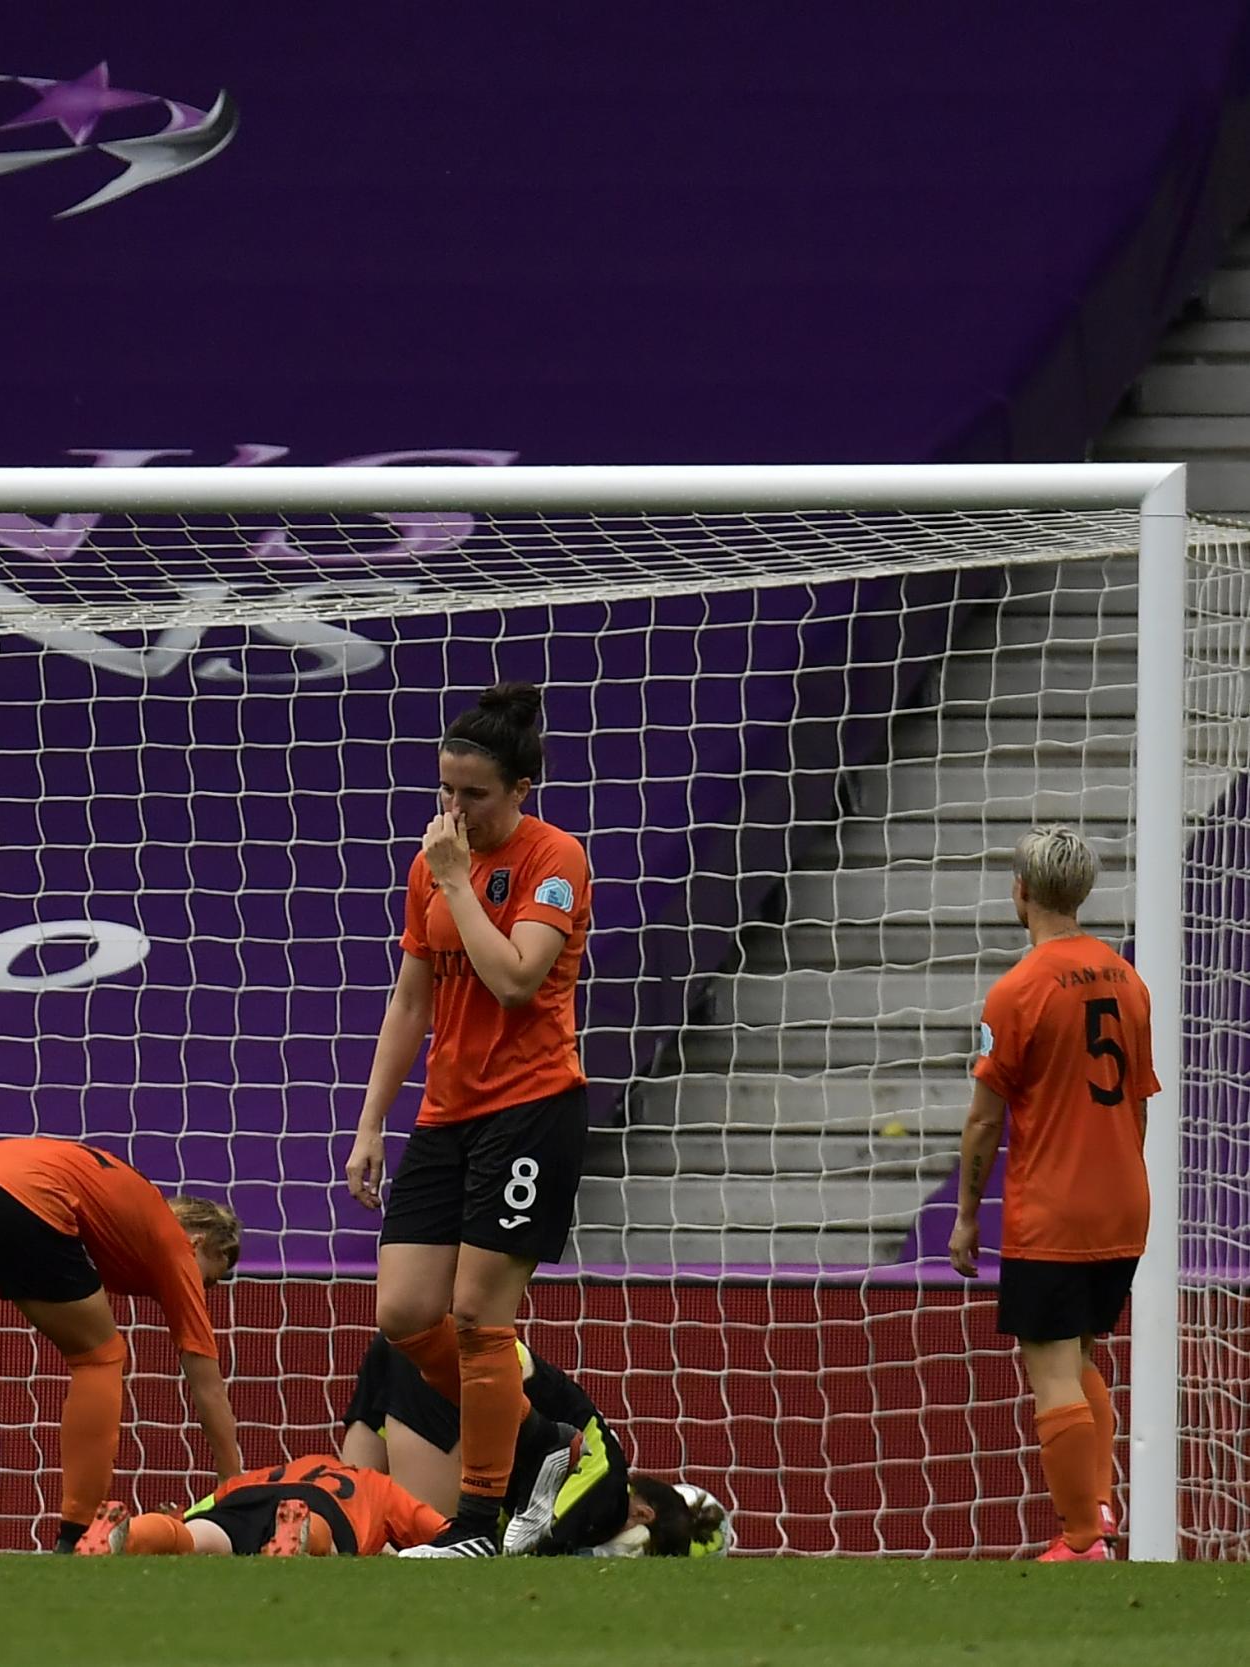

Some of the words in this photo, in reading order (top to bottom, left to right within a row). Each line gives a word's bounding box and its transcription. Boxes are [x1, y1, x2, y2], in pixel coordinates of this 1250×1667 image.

[1054, 967, 1096, 989] VAN
[1084, 997, 1126, 1106] 5
[503, 1156, 539, 1210] 8
